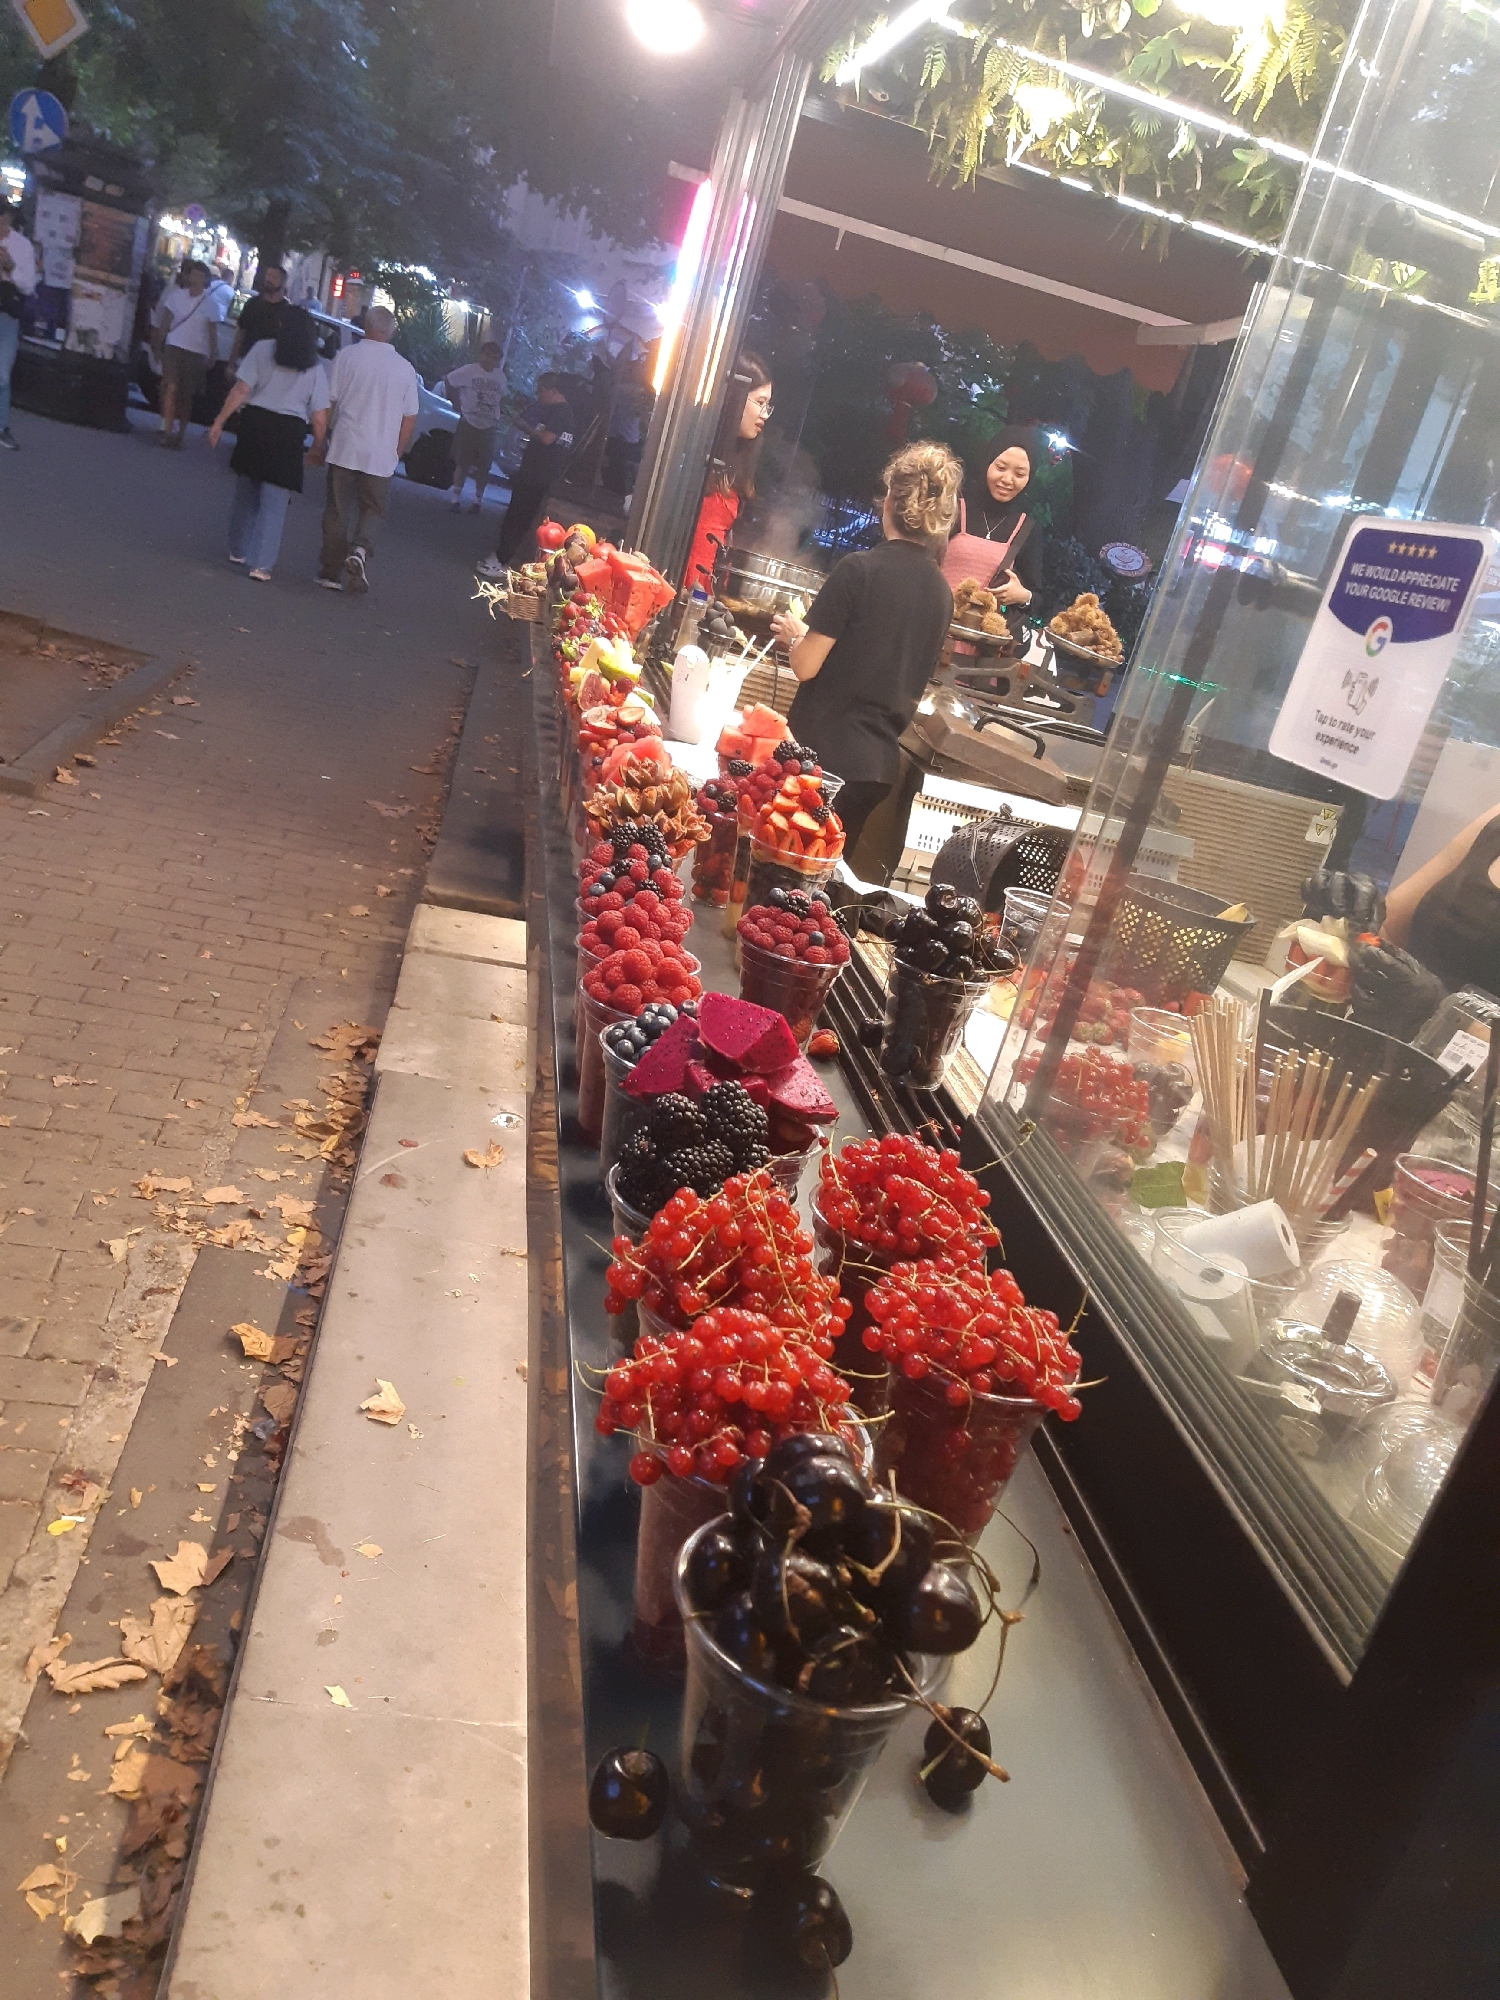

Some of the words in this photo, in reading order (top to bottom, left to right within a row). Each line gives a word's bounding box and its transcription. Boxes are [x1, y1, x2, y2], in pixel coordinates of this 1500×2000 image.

[1350, 562, 1366, 577] WE
[1365, 564, 1399, 582] WOULD
[1398, 569, 1461, 592] APPRECIATE
[1344, 581, 1370, 598] YOUR
[1368, 585, 1409, 605] GOOGLE
[1365, 621, 1388, 657] G
[1315, 709, 1329, 726] Tap
[1329, 716, 1338, 727] to
[1337, 720, 1355, 734] rate
[1354, 726, 1376, 740] your
[1315, 732, 1359, 754] experience
